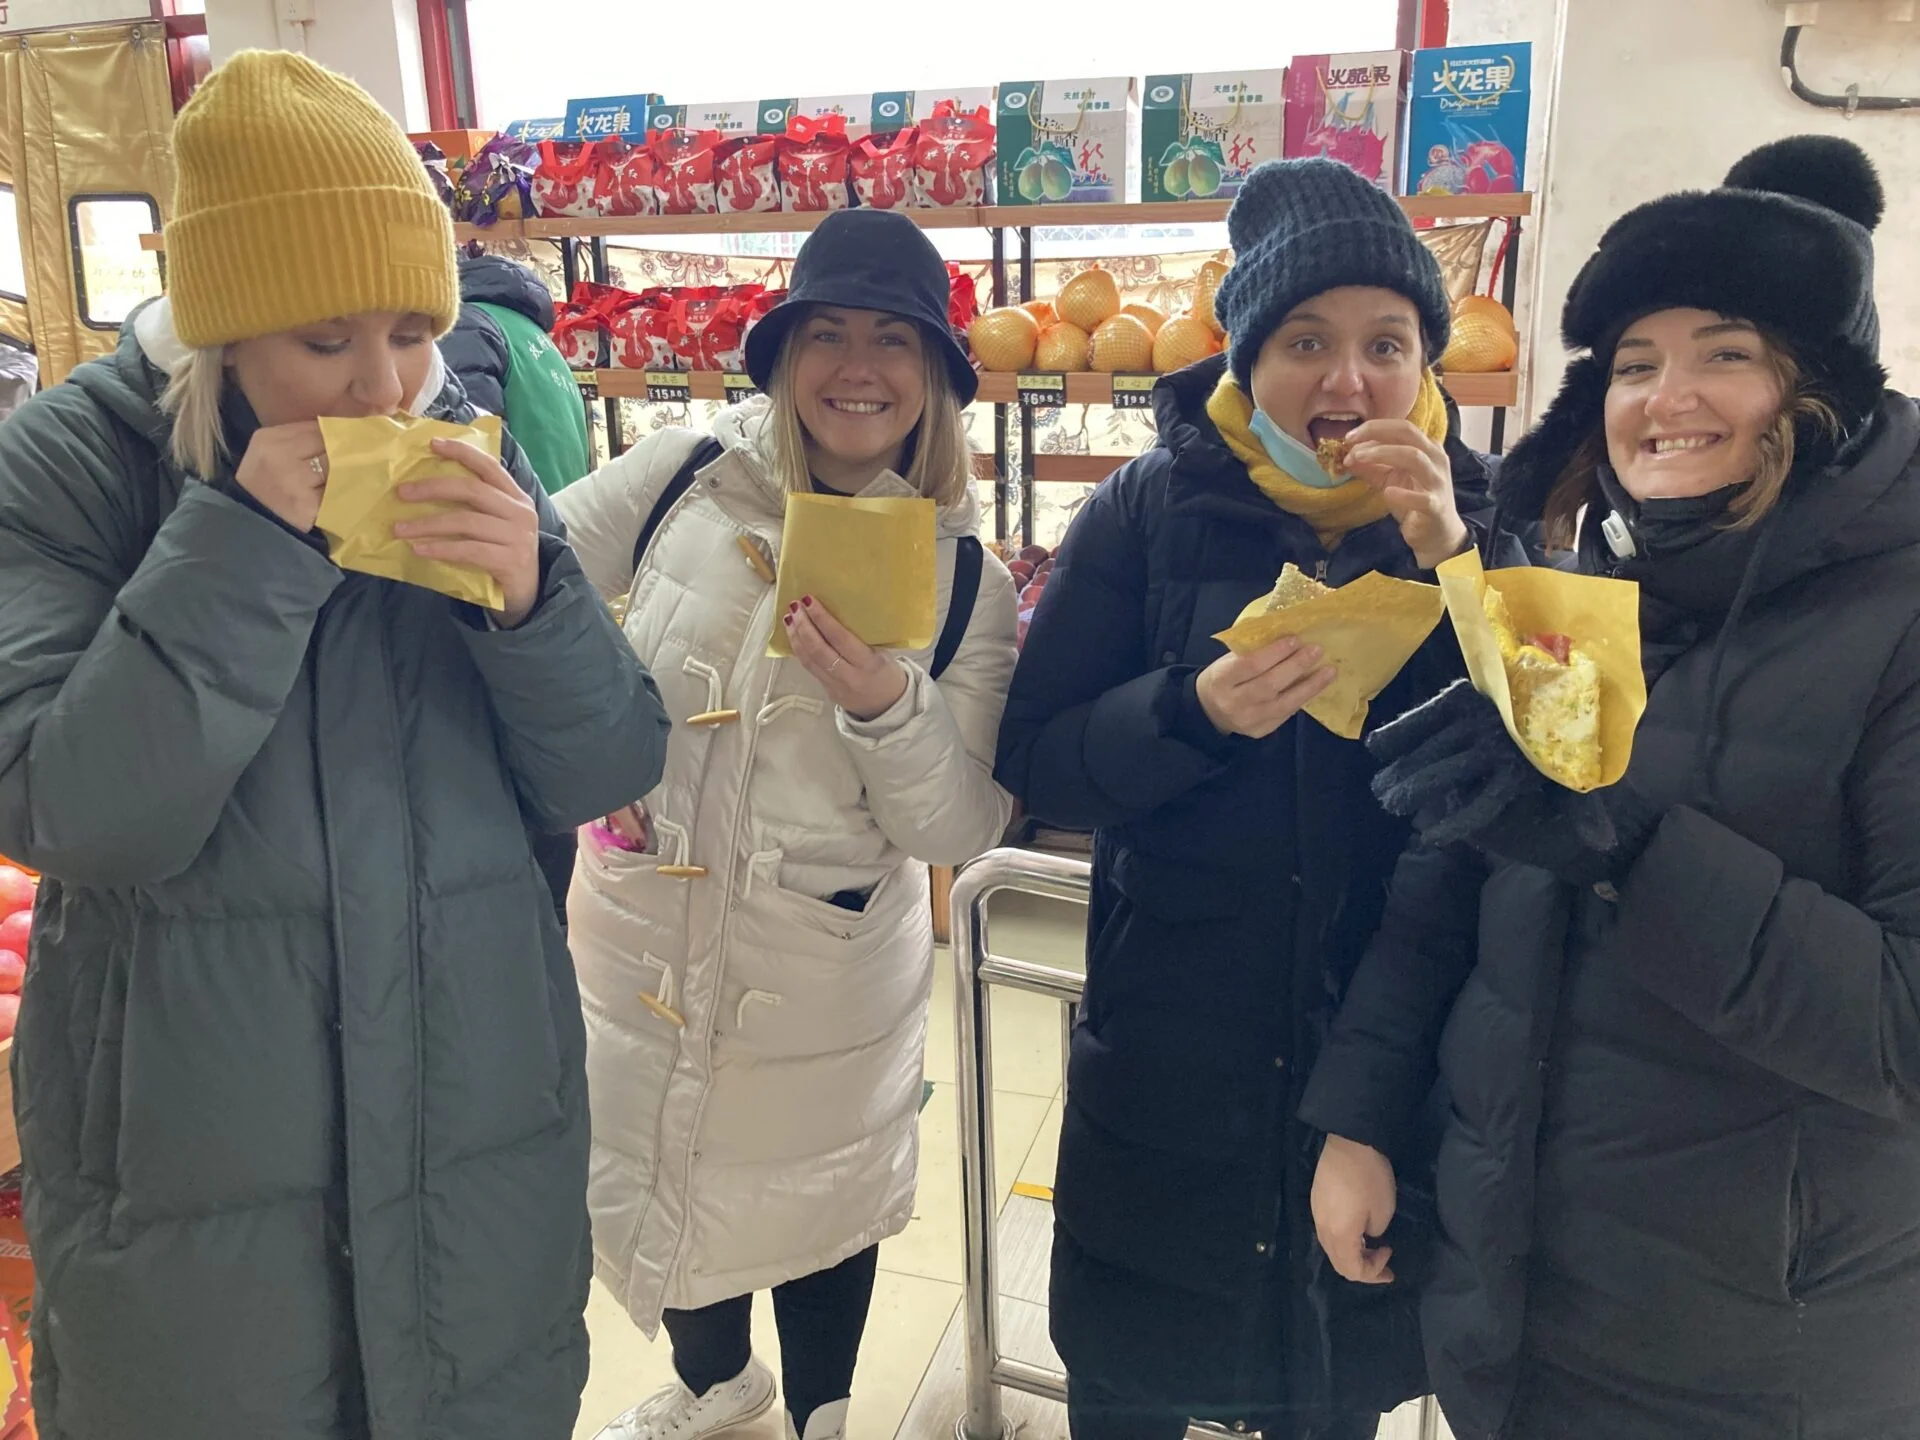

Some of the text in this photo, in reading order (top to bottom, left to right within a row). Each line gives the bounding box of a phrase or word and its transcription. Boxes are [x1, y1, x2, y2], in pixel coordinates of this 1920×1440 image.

[1433, 66, 1509, 92] 火龙果
[576, 112, 631, 134] 火龙果
